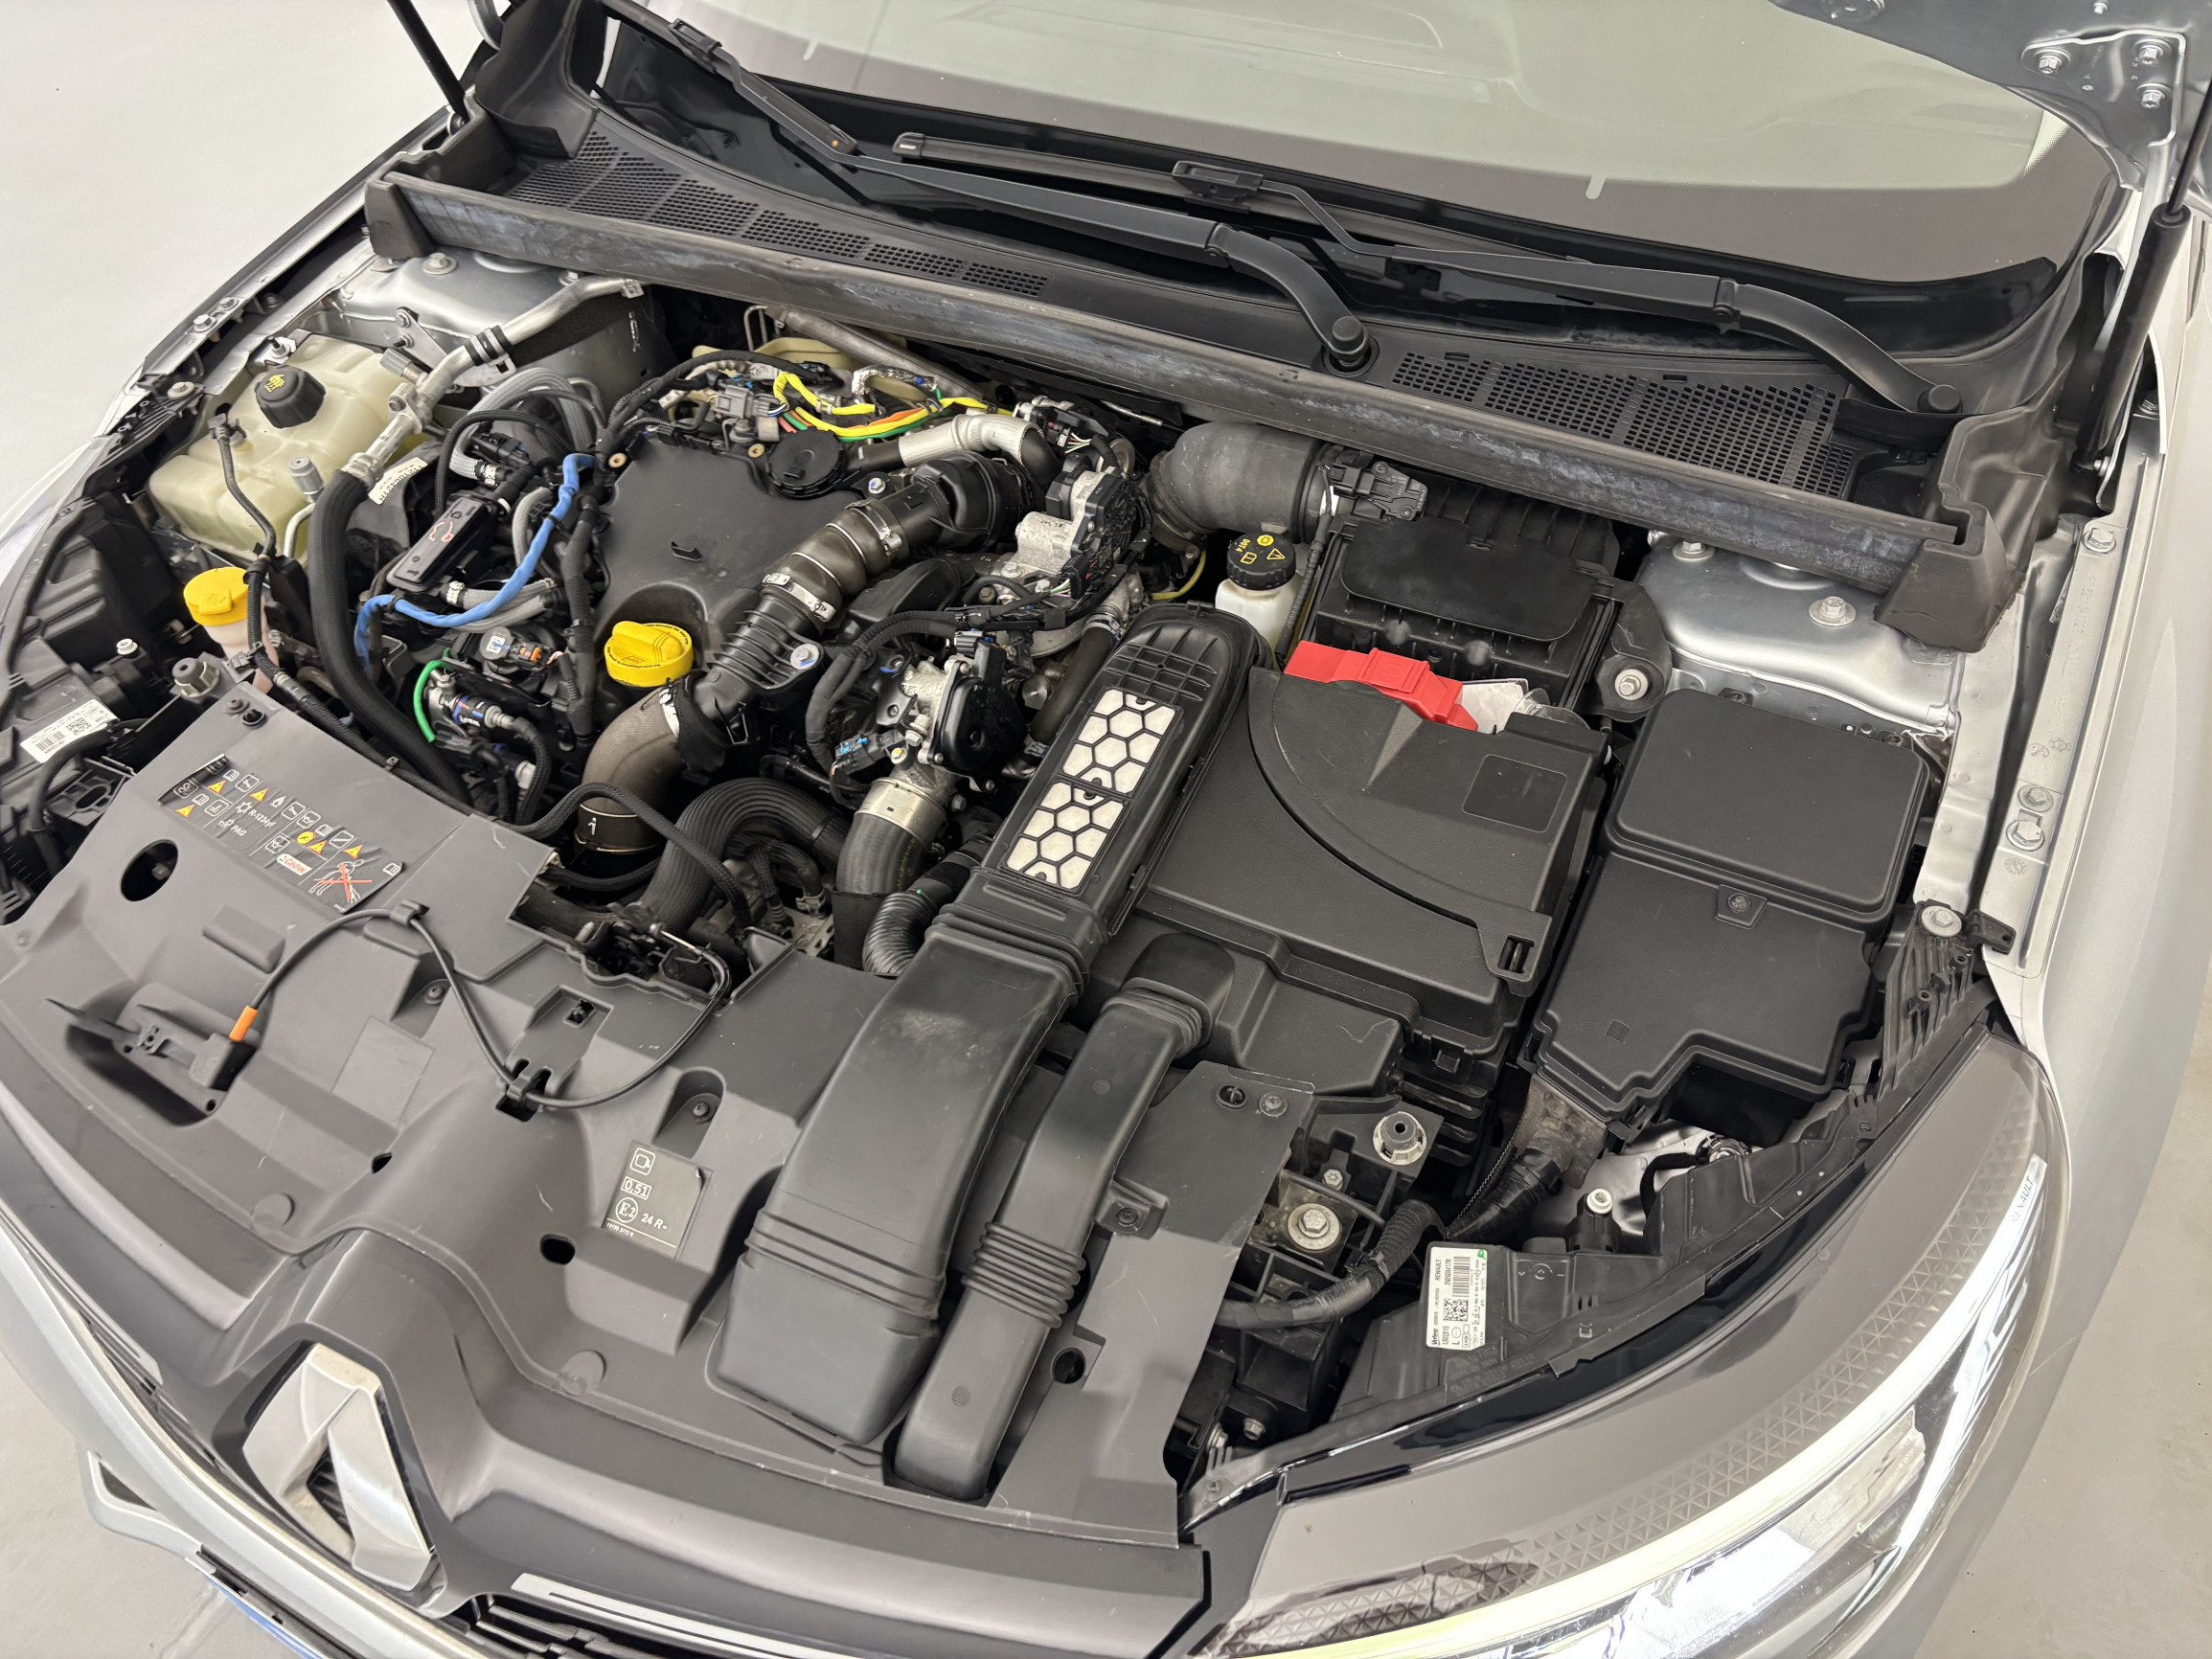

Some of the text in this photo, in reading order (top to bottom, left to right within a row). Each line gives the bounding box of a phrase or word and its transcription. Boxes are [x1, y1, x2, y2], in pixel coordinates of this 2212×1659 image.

[230, 824, 248, 837] PAG
[624, 1179, 648, 1197] 0,51
[2010, 1174, 2036, 1223] RENAULT
[641, 1213, 653, 1225] 24
[1431, 1329, 1440, 1345] Valeo
